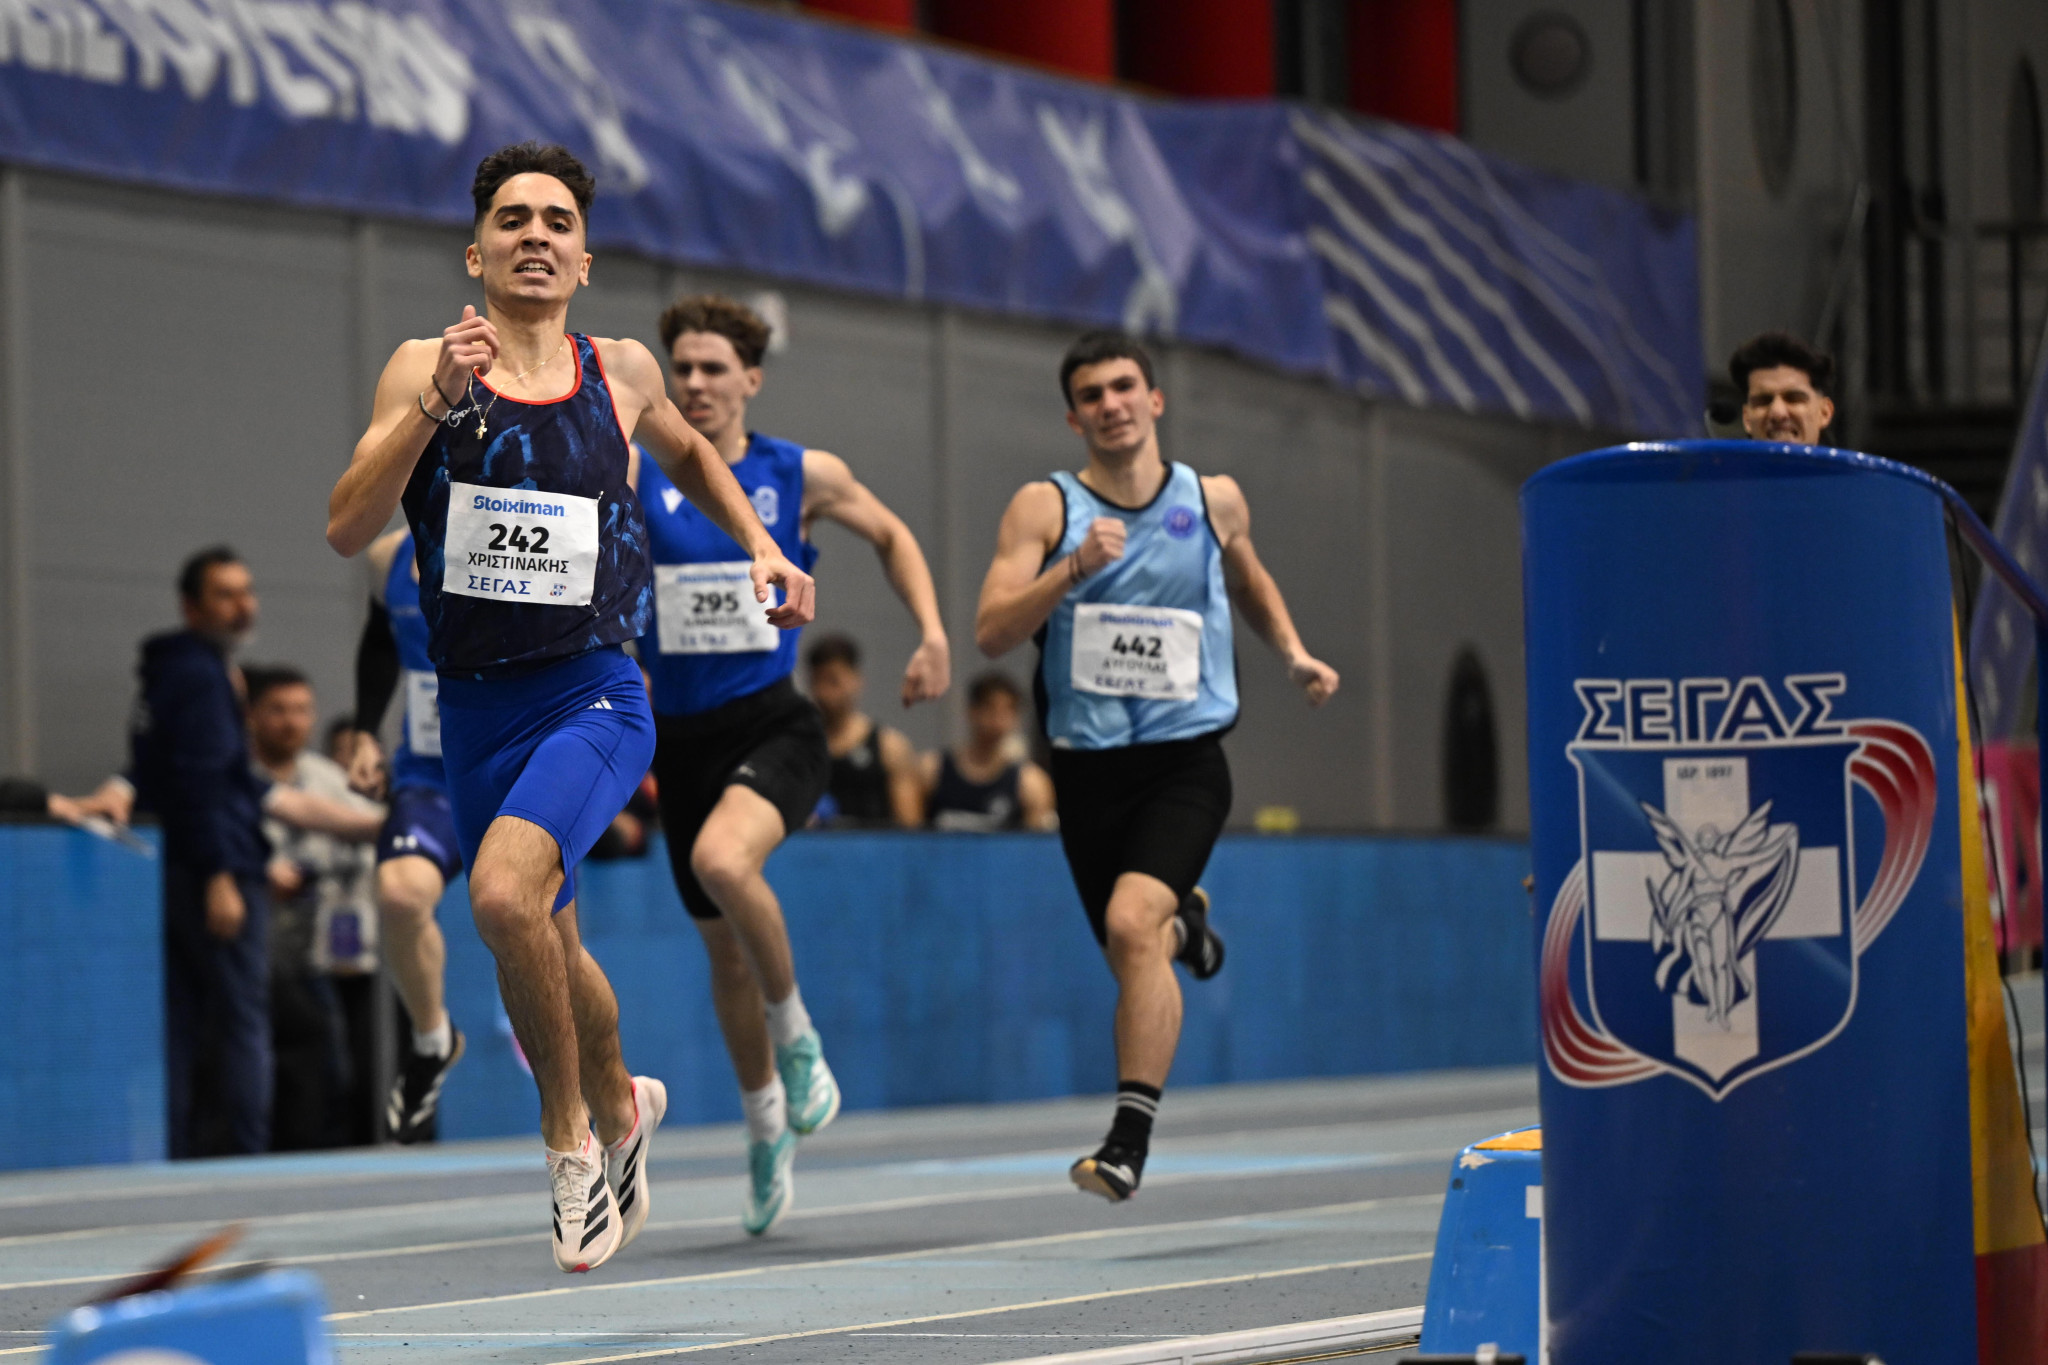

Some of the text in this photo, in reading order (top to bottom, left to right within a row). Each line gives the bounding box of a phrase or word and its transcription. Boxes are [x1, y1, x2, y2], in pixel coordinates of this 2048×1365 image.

[473, 494, 565, 517] Stoiximan
[488, 523, 550, 555] 242
[467, 551, 570, 574] ΧΡΙΣΤΙΝΑΚΗΣ
[467, 575, 531, 595] ΣΕΓΑΣ
[691, 591, 739, 614] 295
[1111, 633, 1162, 659] 442
[1574, 673, 1847, 744] ΣΕΓΑΣ
